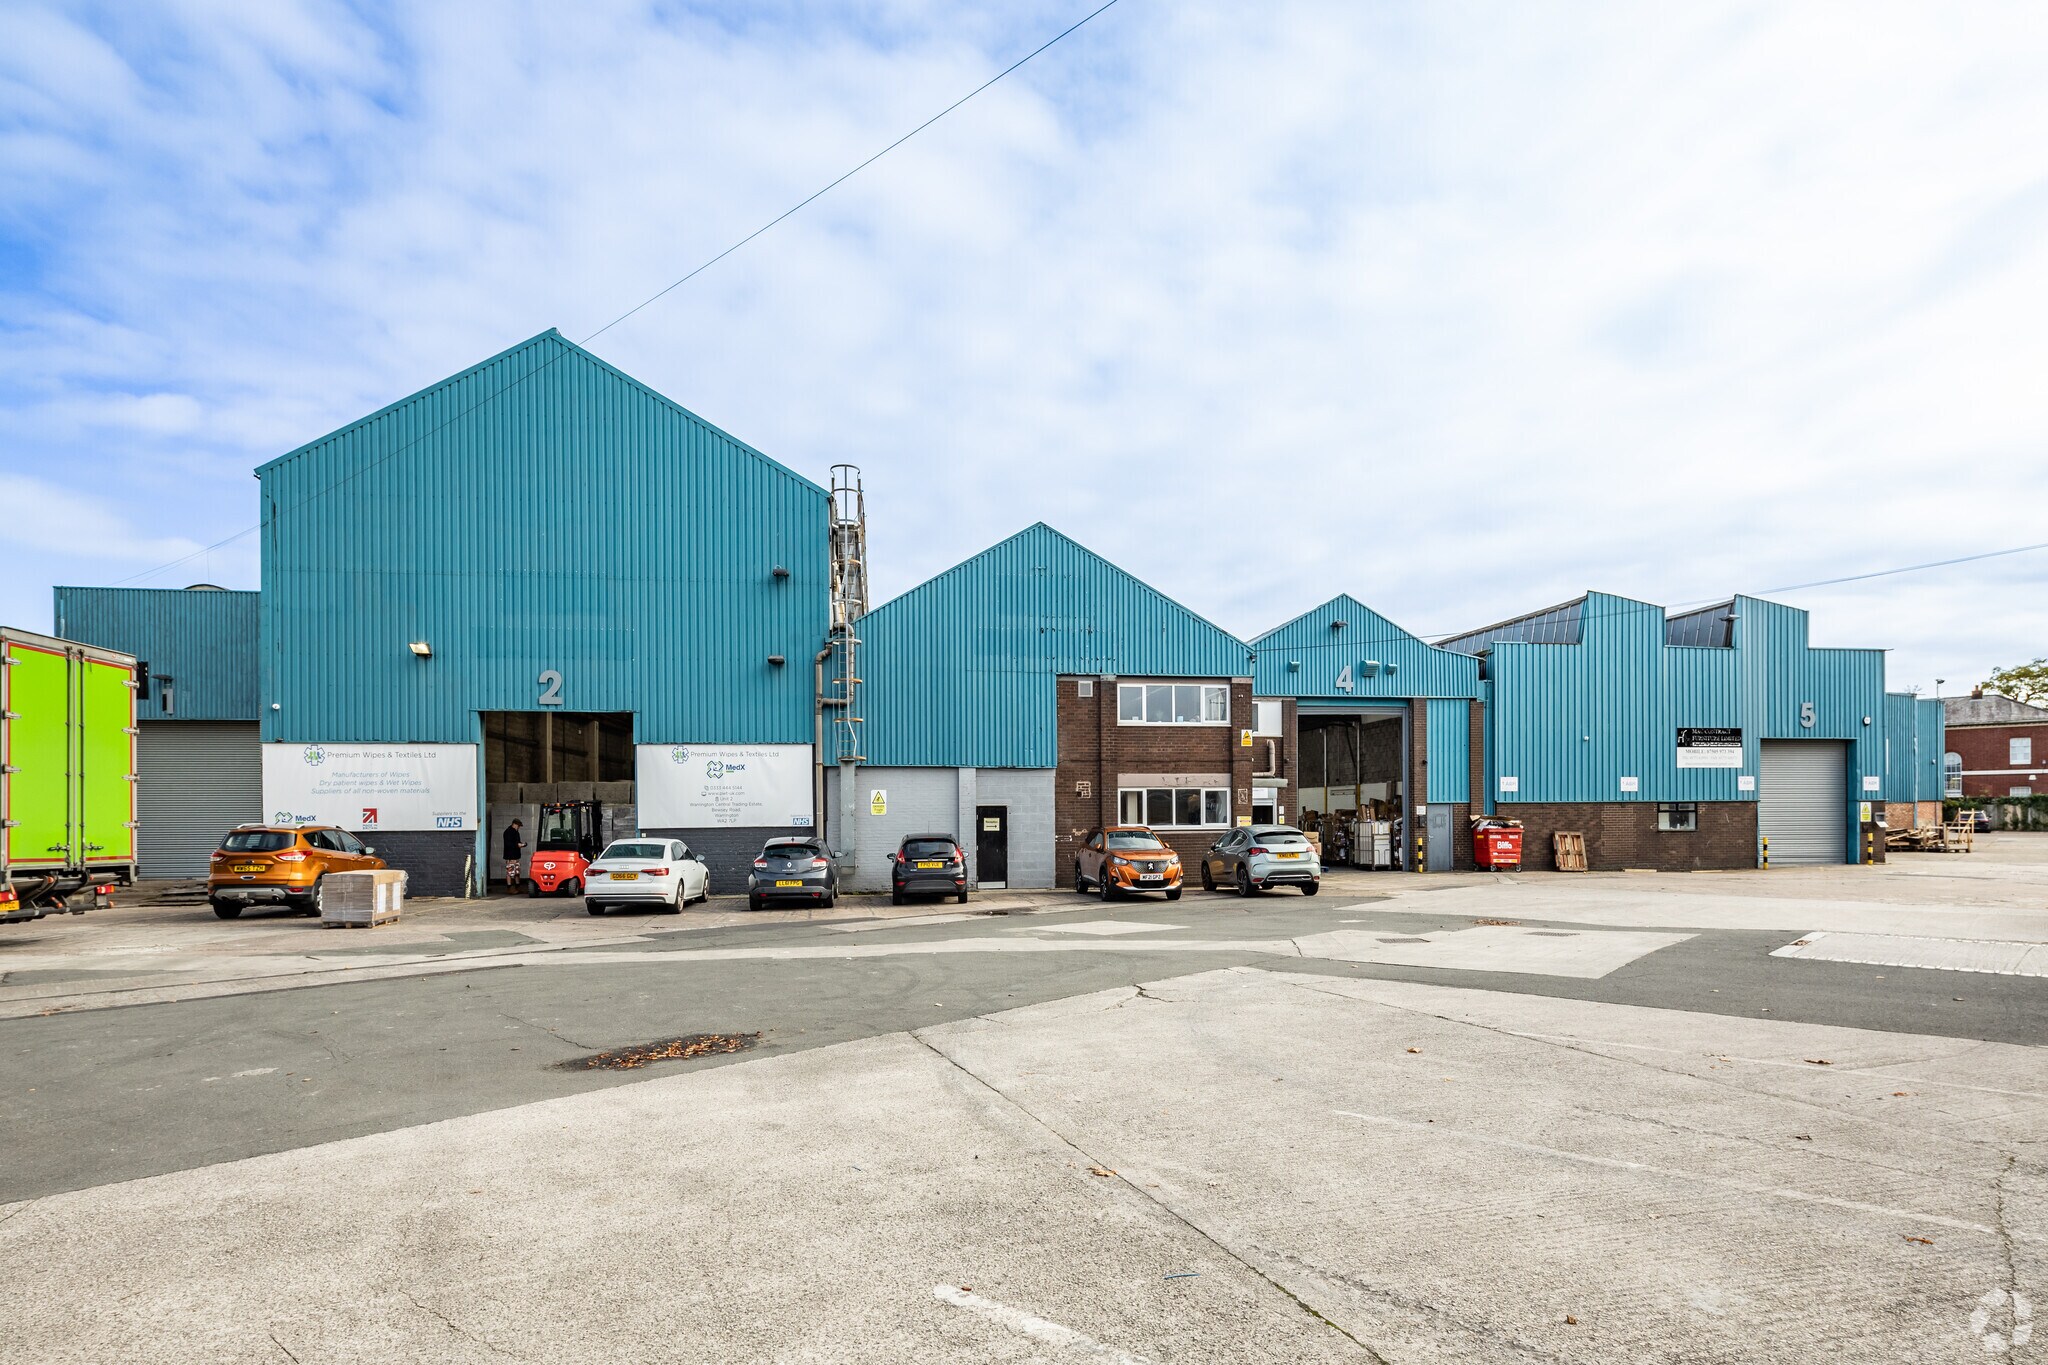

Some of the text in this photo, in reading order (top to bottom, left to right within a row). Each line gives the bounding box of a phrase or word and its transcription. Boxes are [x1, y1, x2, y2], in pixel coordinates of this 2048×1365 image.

[1336, 665, 1354, 692] 4
[538, 669, 563, 705] 2
[1800, 702, 1816, 728] 5
[363, 751, 386, 760] Wipes
[389, 771, 410, 779] Wipes
[437, 818, 461, 827] NHS
[1497, 841, 1512, 849] Biffa
